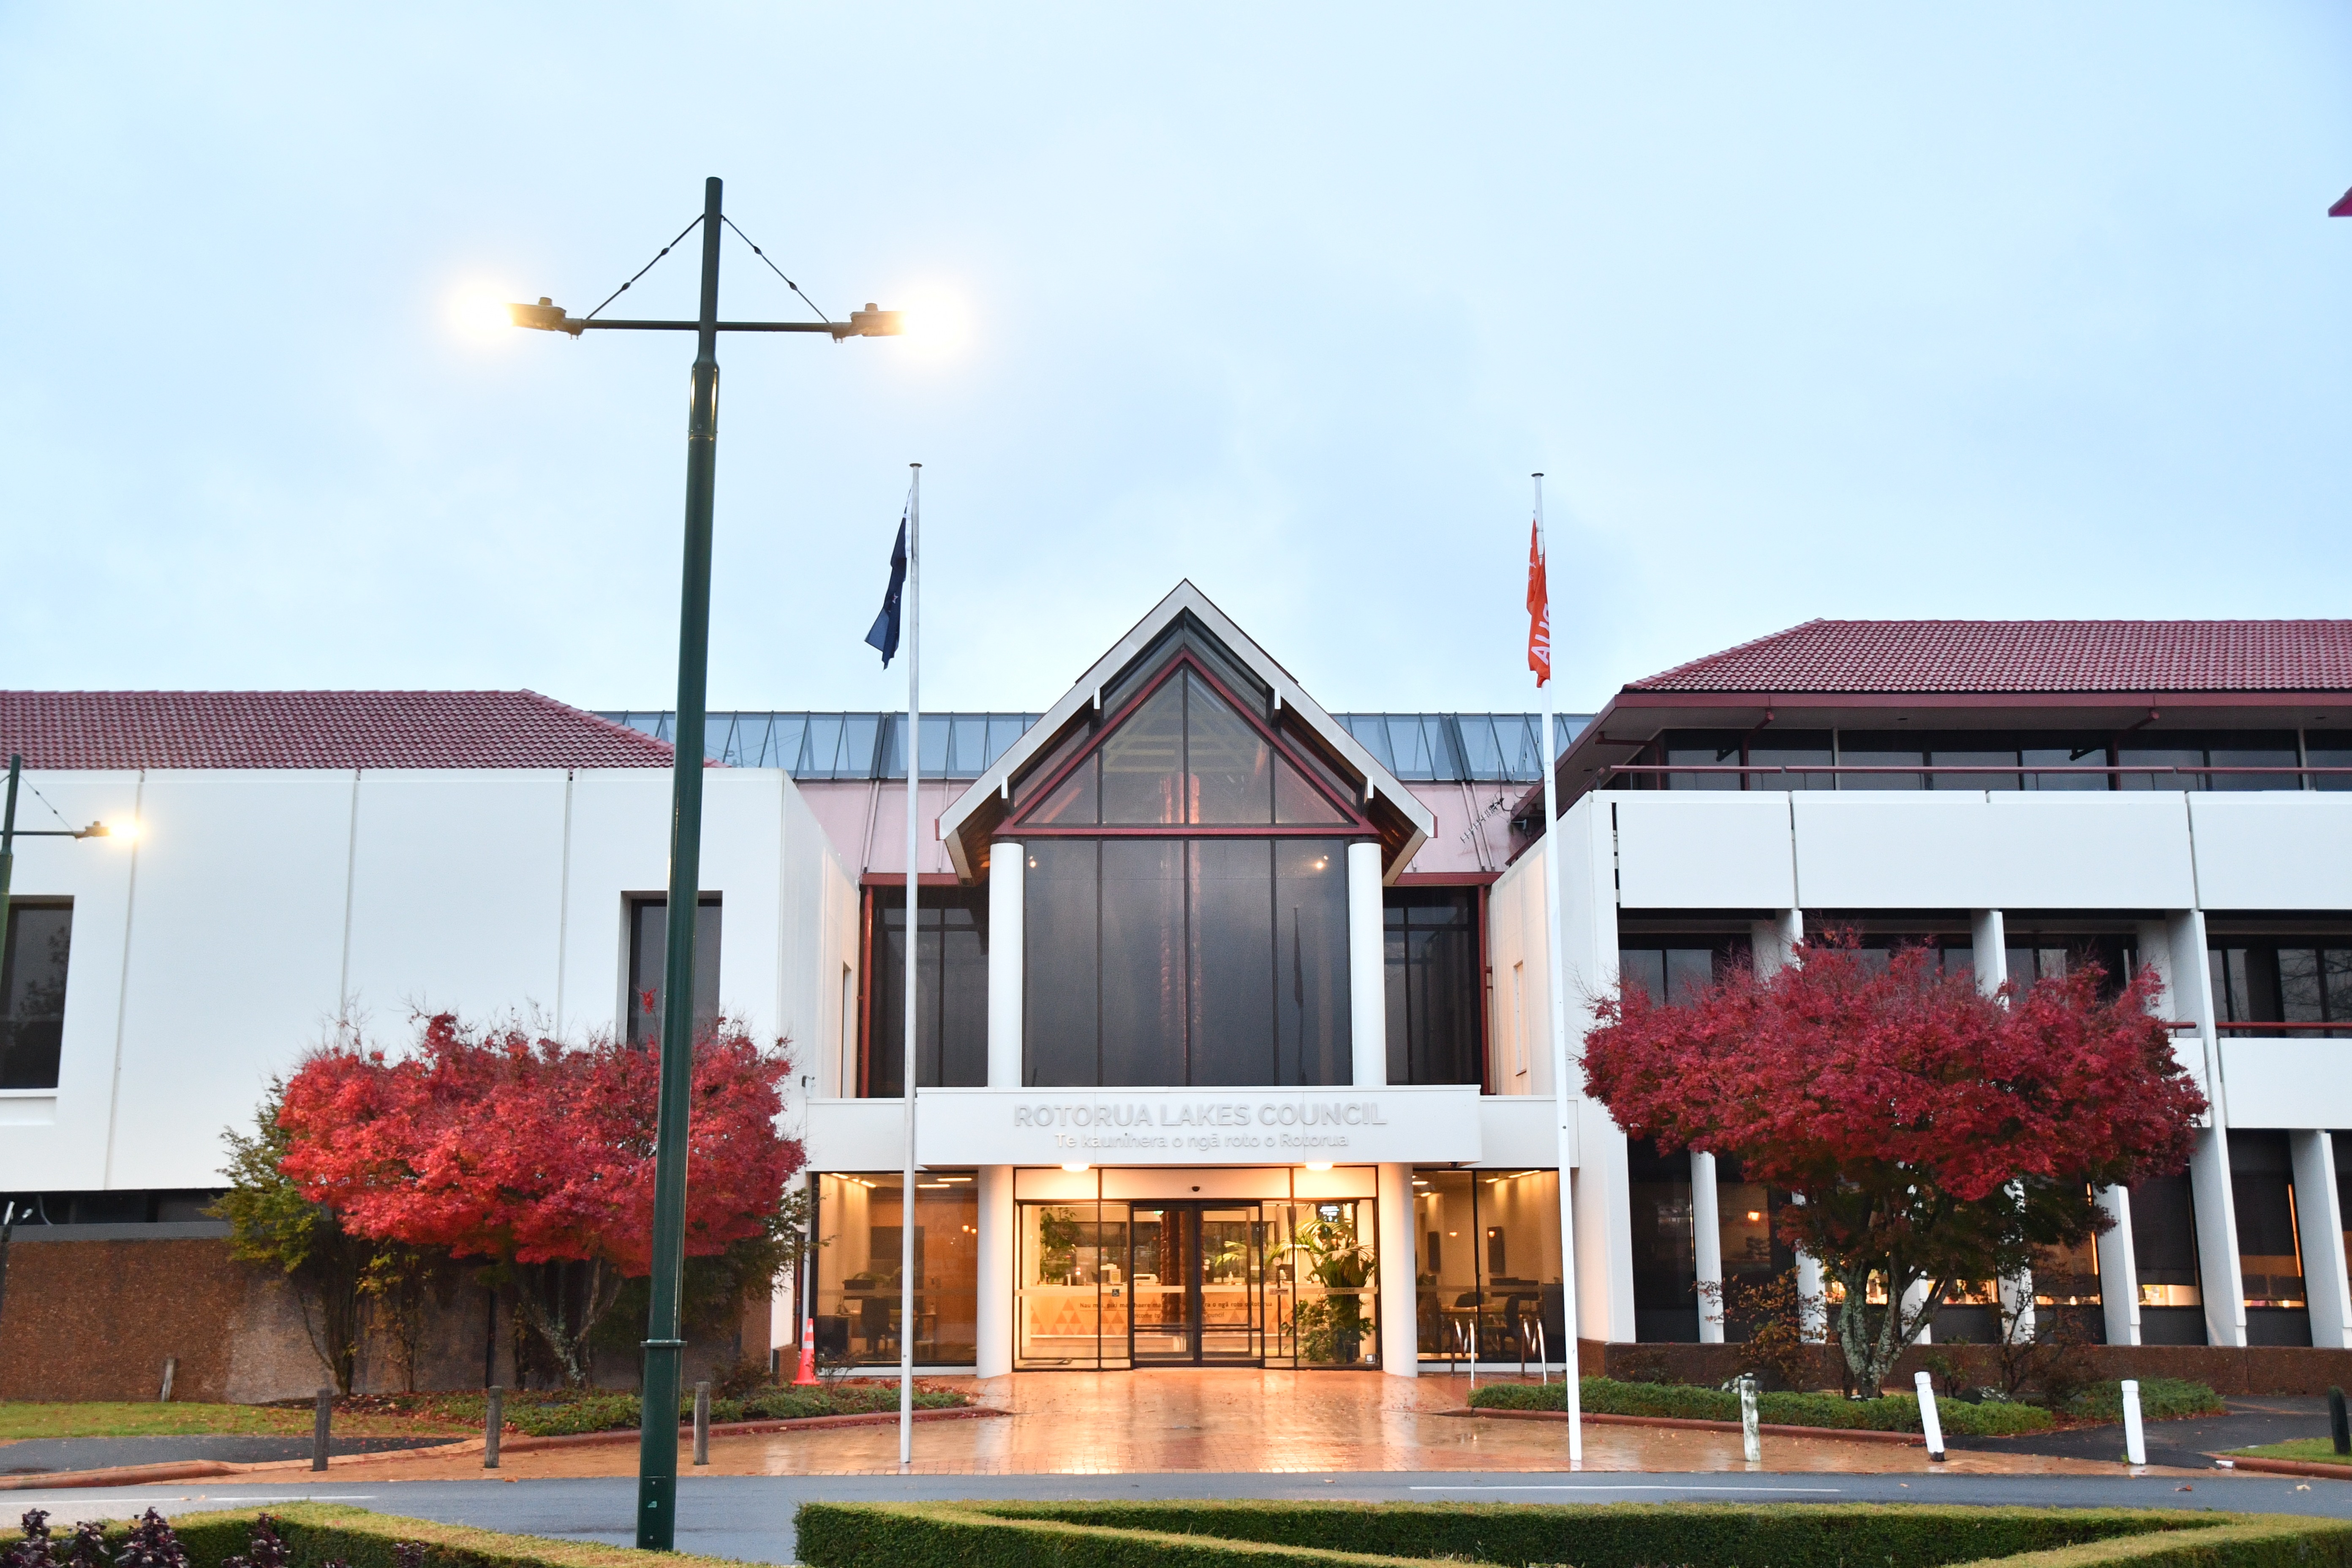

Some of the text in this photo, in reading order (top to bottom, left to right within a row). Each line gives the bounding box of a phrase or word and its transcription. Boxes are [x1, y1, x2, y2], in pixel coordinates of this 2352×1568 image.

[1015, 1102, 1388, 1126] ROTORUA LAKES COUNCIL
[1055, 1132, 1349, 1151] Te kaunihera o ngā roto o Rotorua
